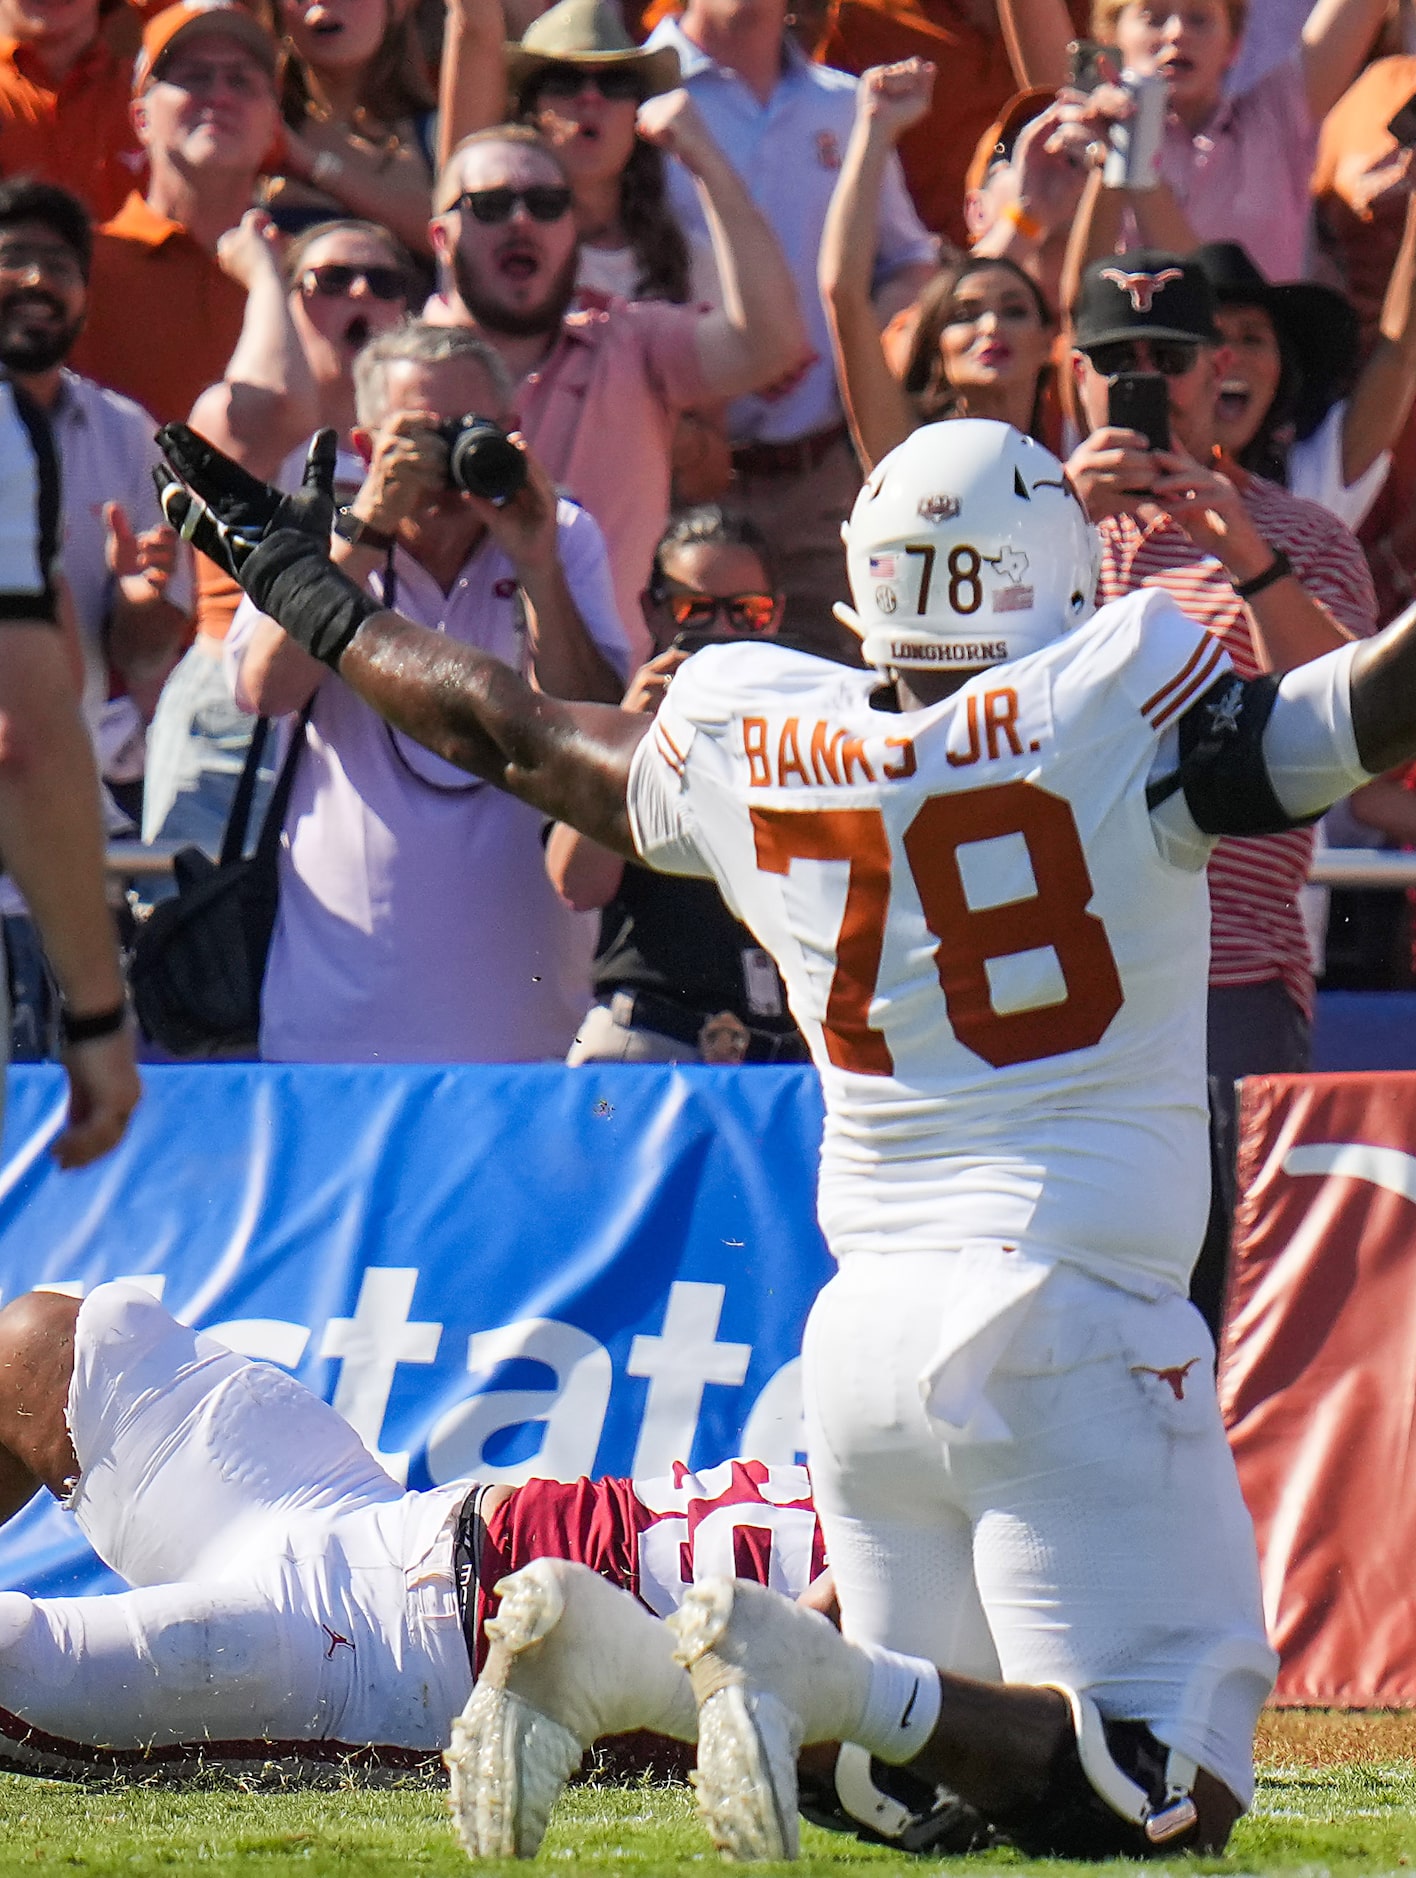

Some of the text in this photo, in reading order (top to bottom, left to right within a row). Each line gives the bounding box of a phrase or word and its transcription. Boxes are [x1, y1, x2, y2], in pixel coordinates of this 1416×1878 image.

[905, 544, 983, 615] 78
[890, 641, 1009, 661] LONGHORNS
[946, 687, 1041, 768] JR.
[748, 778, 1126, 1077] 78
